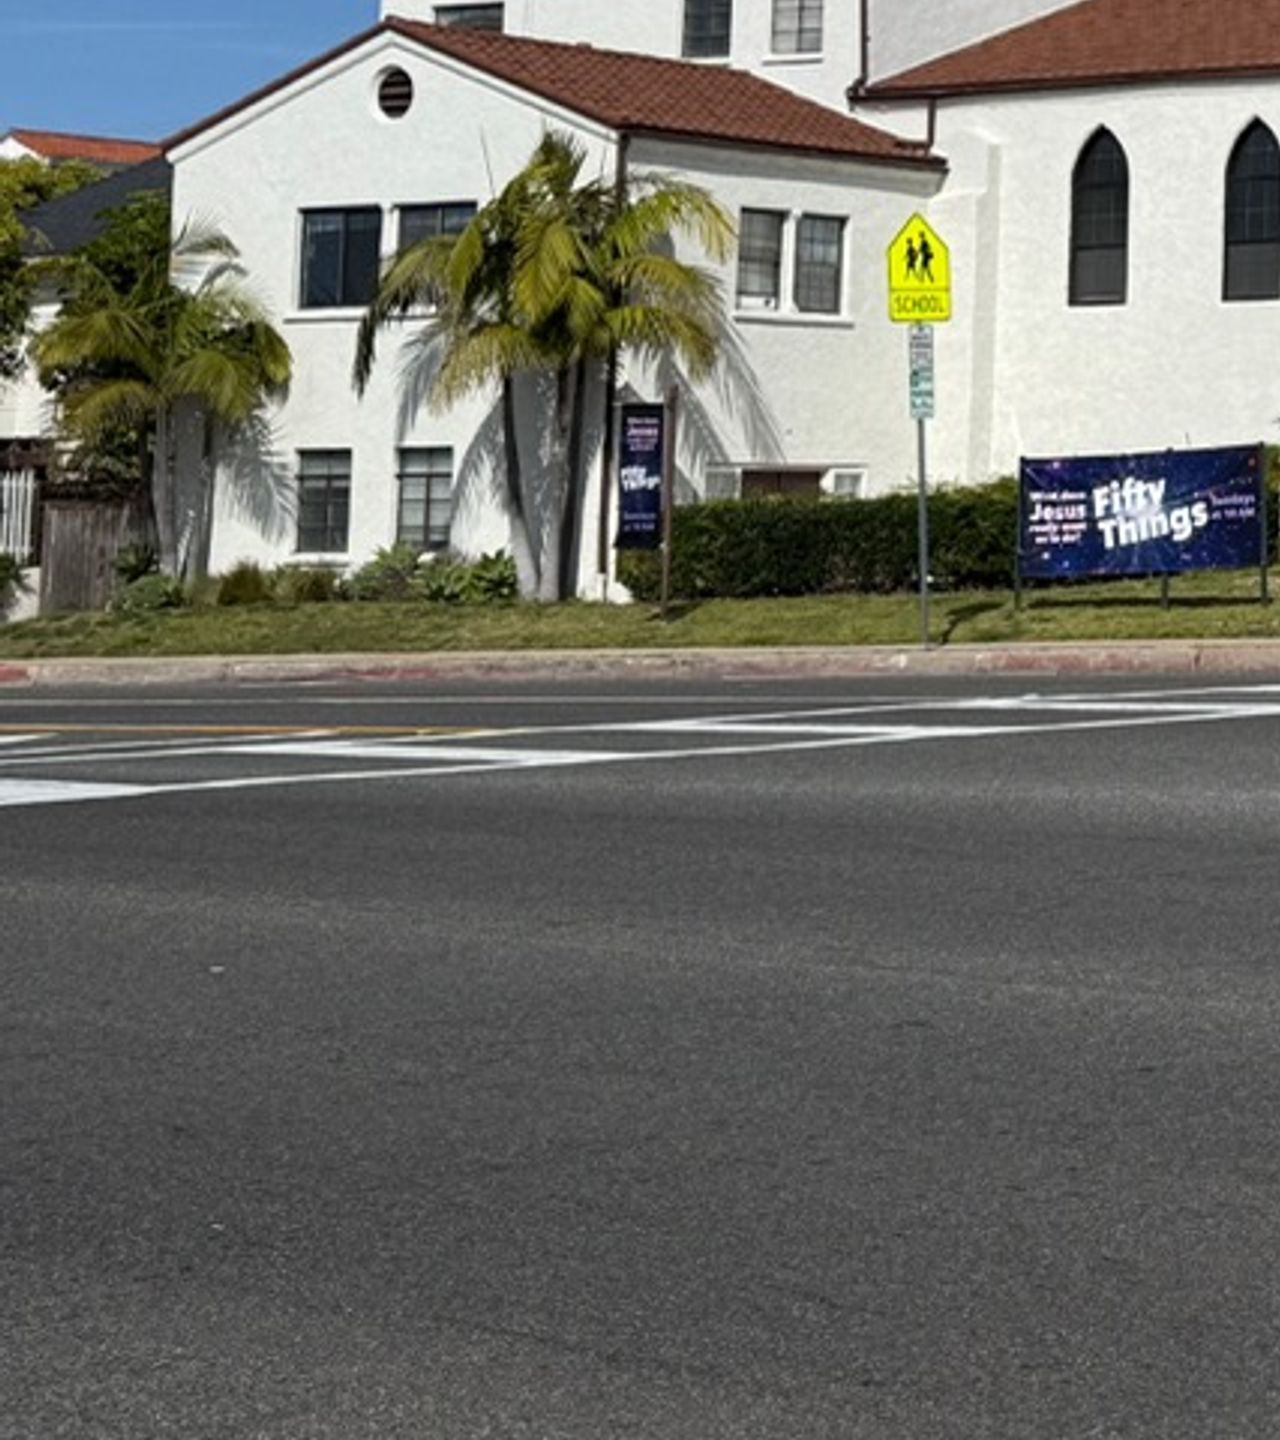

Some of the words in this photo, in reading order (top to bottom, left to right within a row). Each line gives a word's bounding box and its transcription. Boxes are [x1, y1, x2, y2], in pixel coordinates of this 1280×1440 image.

[894, 294, 944, 313] SCHOOL
[1092, 476, 1166, 518] Fifty
[1029, 504, 1087, 521] Jesus
[1097, 500, 1208, 550] Things
